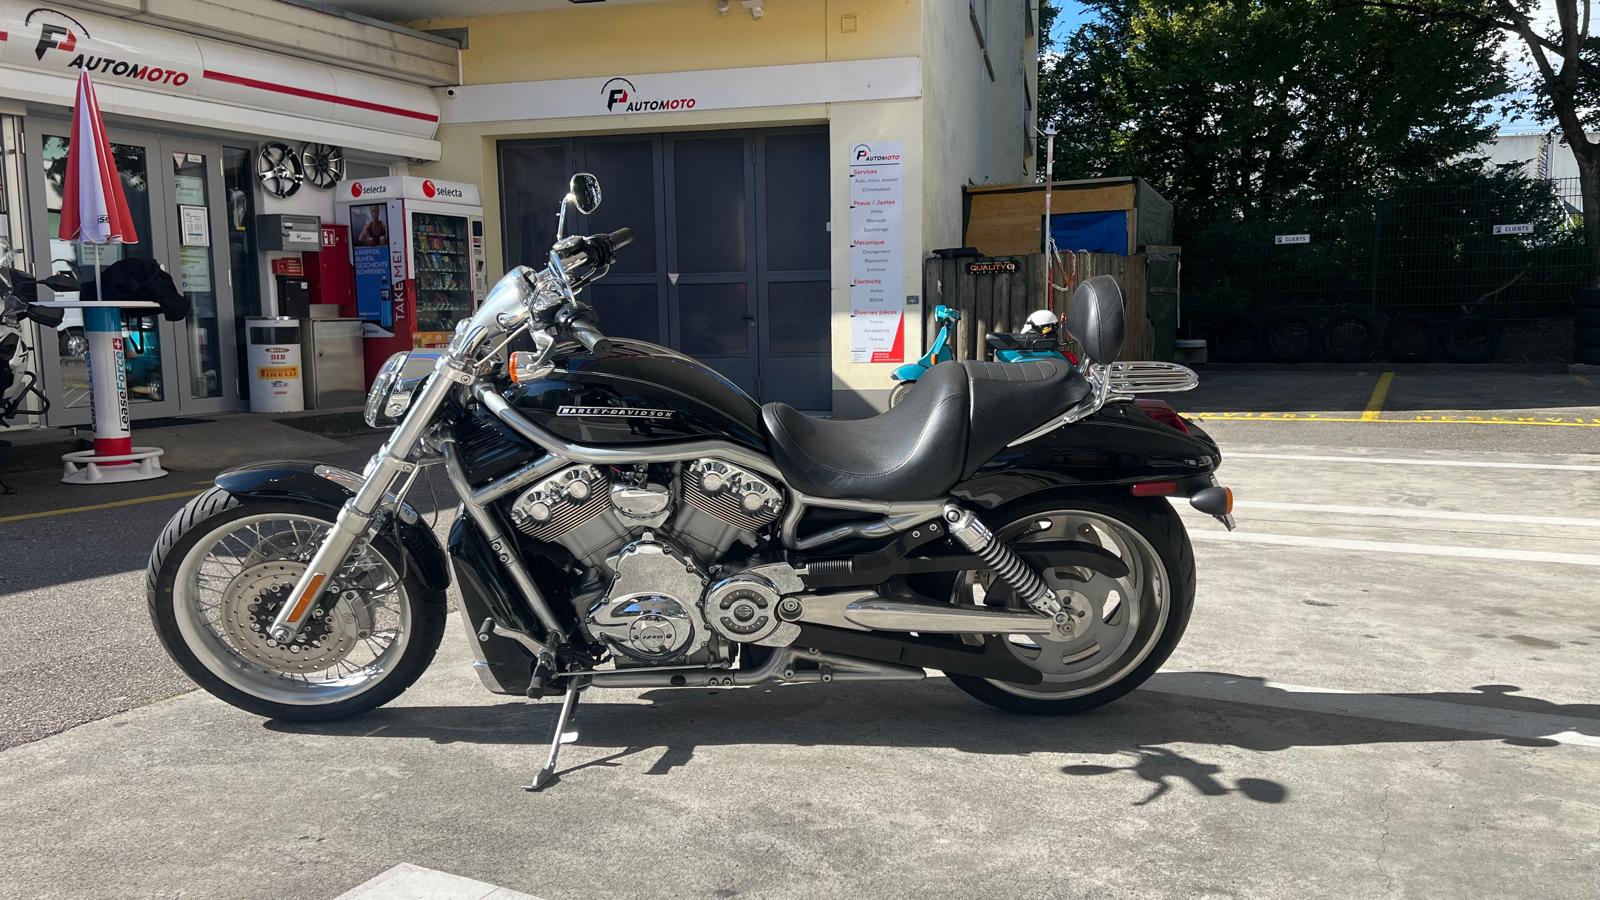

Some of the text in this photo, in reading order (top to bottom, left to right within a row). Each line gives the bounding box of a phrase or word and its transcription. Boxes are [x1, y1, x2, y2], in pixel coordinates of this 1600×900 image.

[68, 54, 189, 87] AUTOMOTO
[626, 98, 696, 112] AUTOMOTO
[865, 154, 900, 162] AUTOMOTO
[363, 185, 387, 194] selecta
[437, 187, 463, 198] selecta
[392, 250, 405, 322] TAKE ME!
[115, 351, 130, 432] LeaseForce
[561, 407, 673, 418] HARLEY-DAVIDSON
